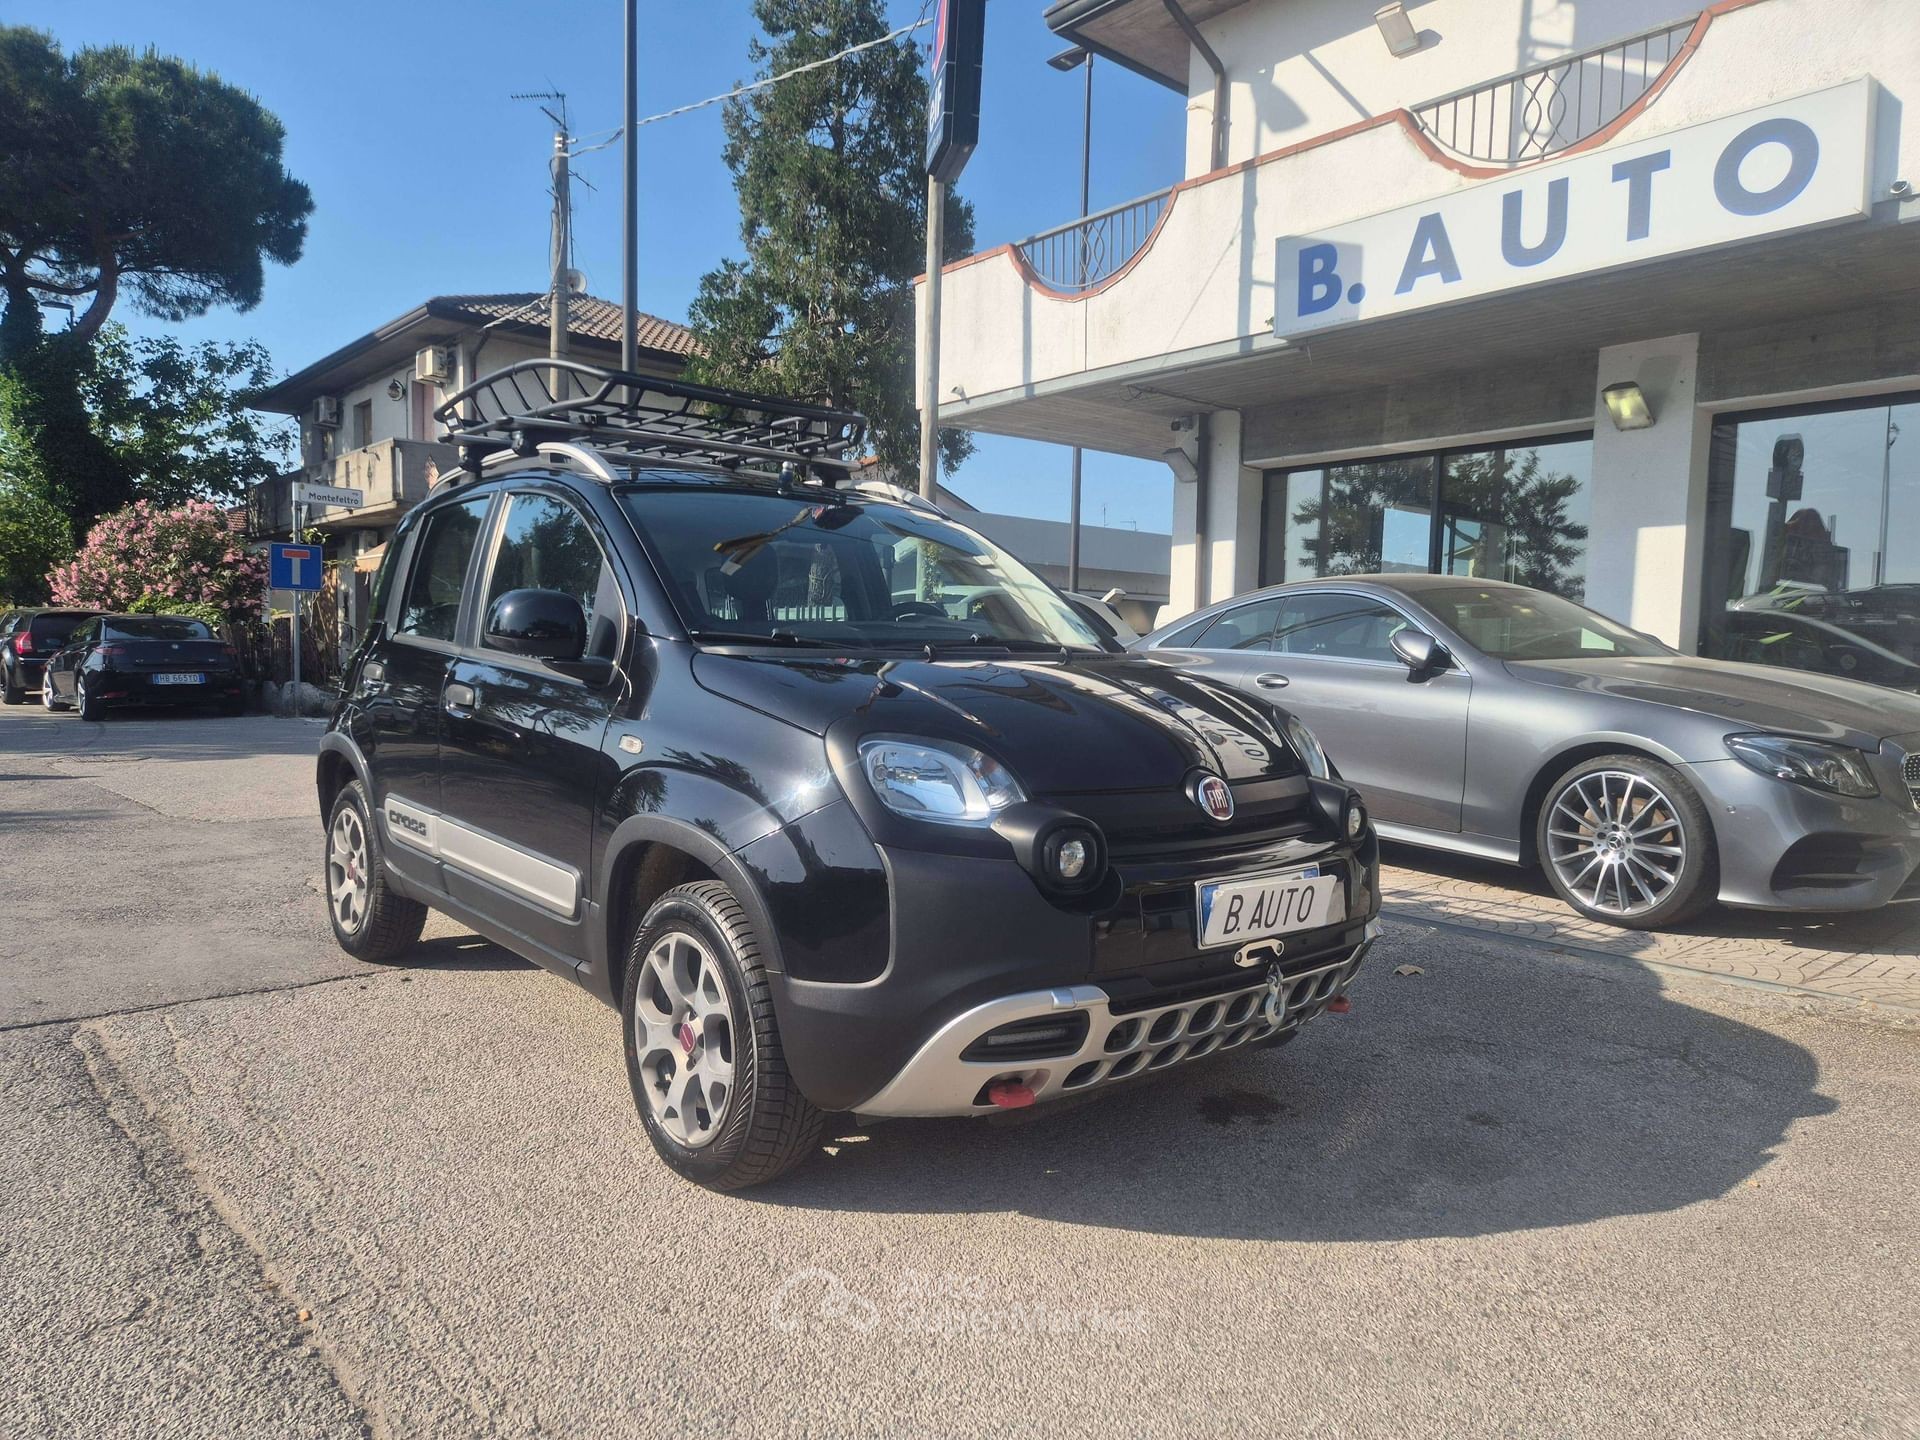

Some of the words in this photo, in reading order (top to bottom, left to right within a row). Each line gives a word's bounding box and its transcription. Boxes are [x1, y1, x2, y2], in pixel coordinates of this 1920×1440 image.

[1297, 243, 1366, 318] B.
[1394, 116, 1820, 296] AUTO
[308, 491, 359, 505] Montefeltro
[159, 674, 170, 682] HB
[1207, 788, 1228, 810] FIAT
[1248, 885, 1315, 930] AUTO
